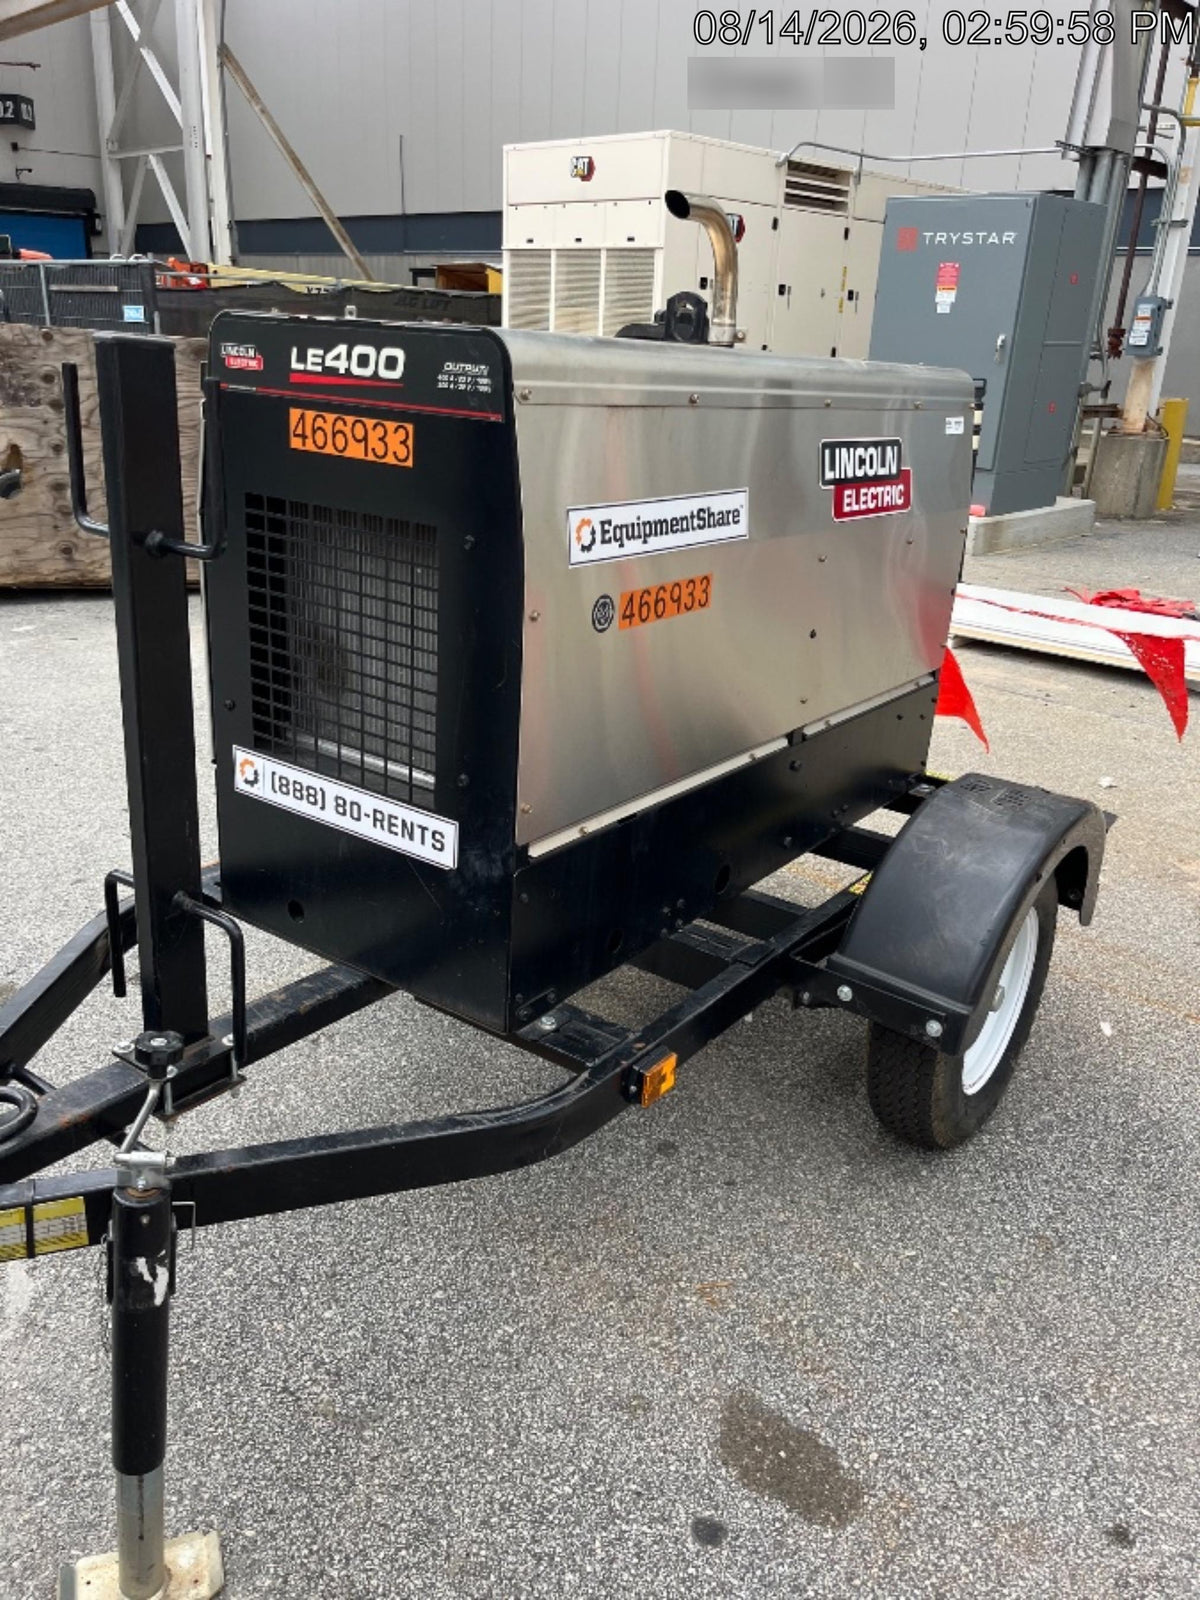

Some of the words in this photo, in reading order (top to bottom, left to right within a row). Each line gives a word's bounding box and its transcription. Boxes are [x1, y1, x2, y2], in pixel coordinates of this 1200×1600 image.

[922, 231, 1017, 245] TRYSTAR
[221, 345, 255, 358] LINCOLN
[290, 344, 406, 379] LE400
[292, 411, 411, 463] 466933
[824, 445, 898, 481] LINCOLN
[842, 484, 904, 513] ELECTRIC
[599, 505, 741, 548] EquipmentShare
[622, 575, 711, 627] 466933
[270, 771, 326, 811] (888)
[334, 796, 445, 852] 80-RENTS
